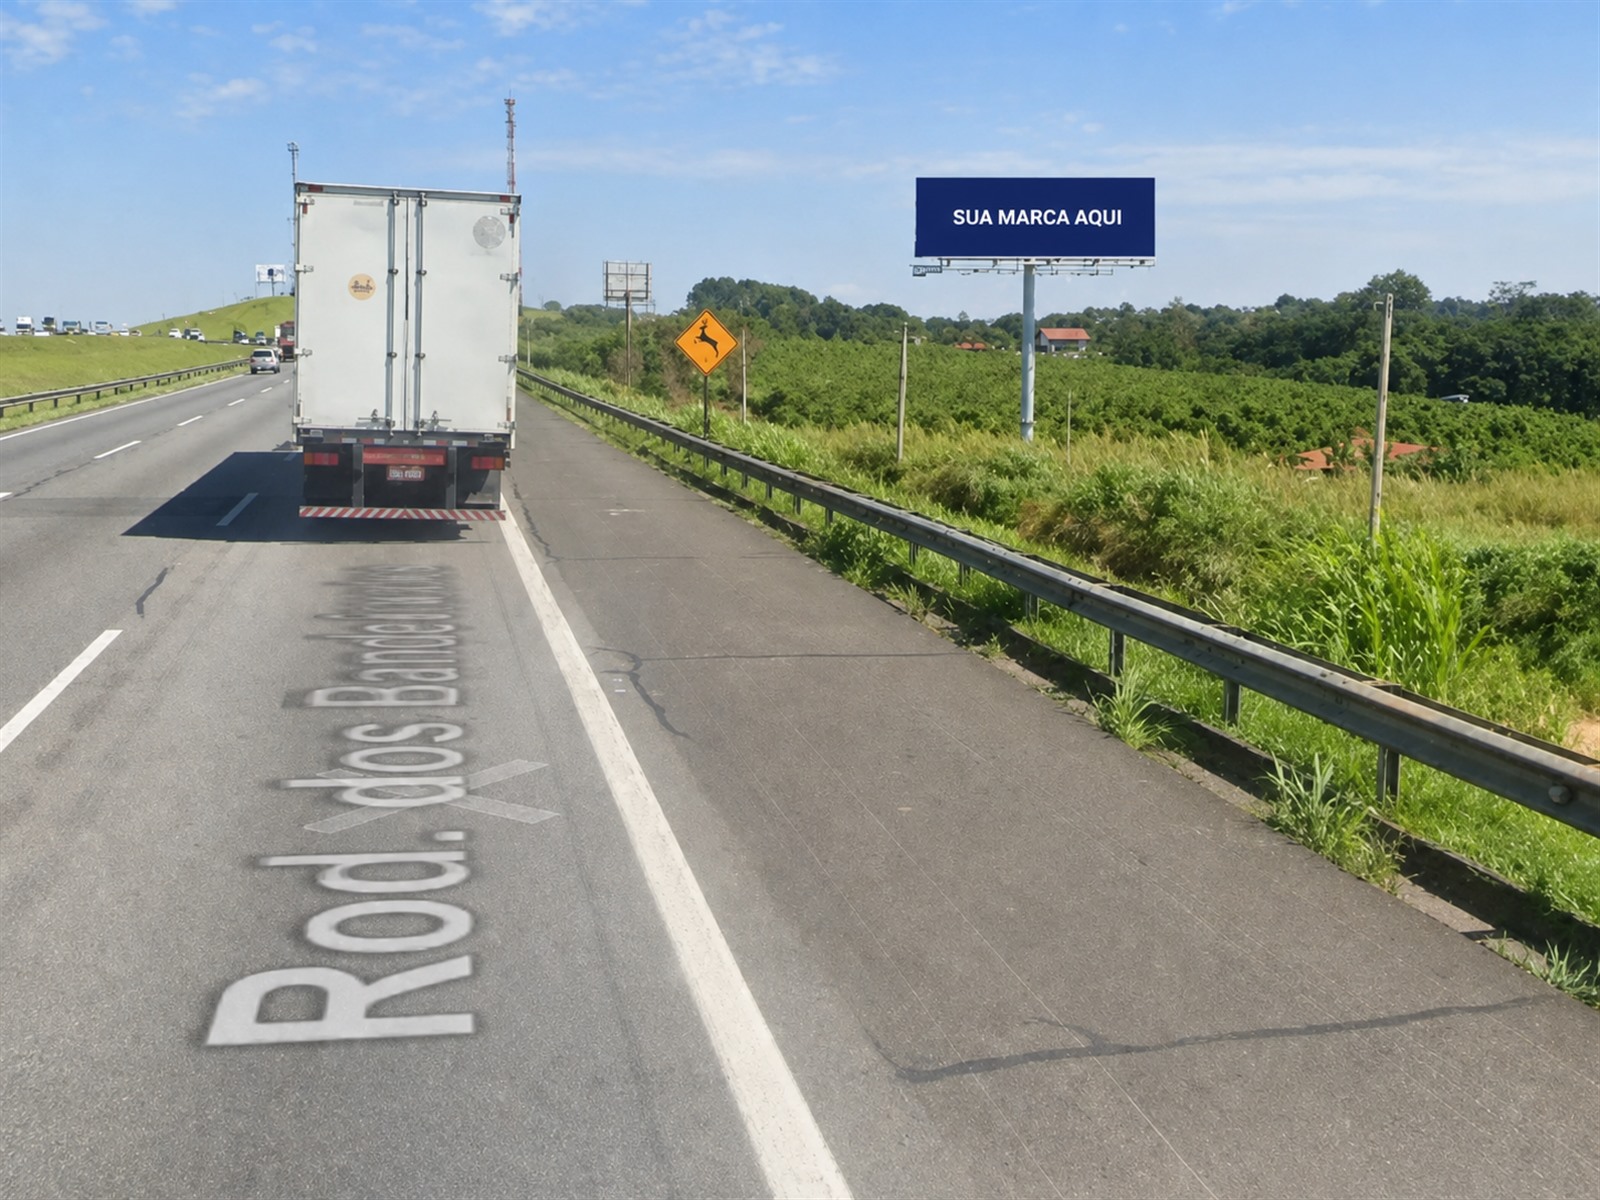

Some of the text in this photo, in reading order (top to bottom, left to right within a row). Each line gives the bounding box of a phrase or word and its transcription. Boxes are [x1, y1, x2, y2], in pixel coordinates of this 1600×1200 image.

[953, 209, 1122, 227] SUA MARCA AQUI
